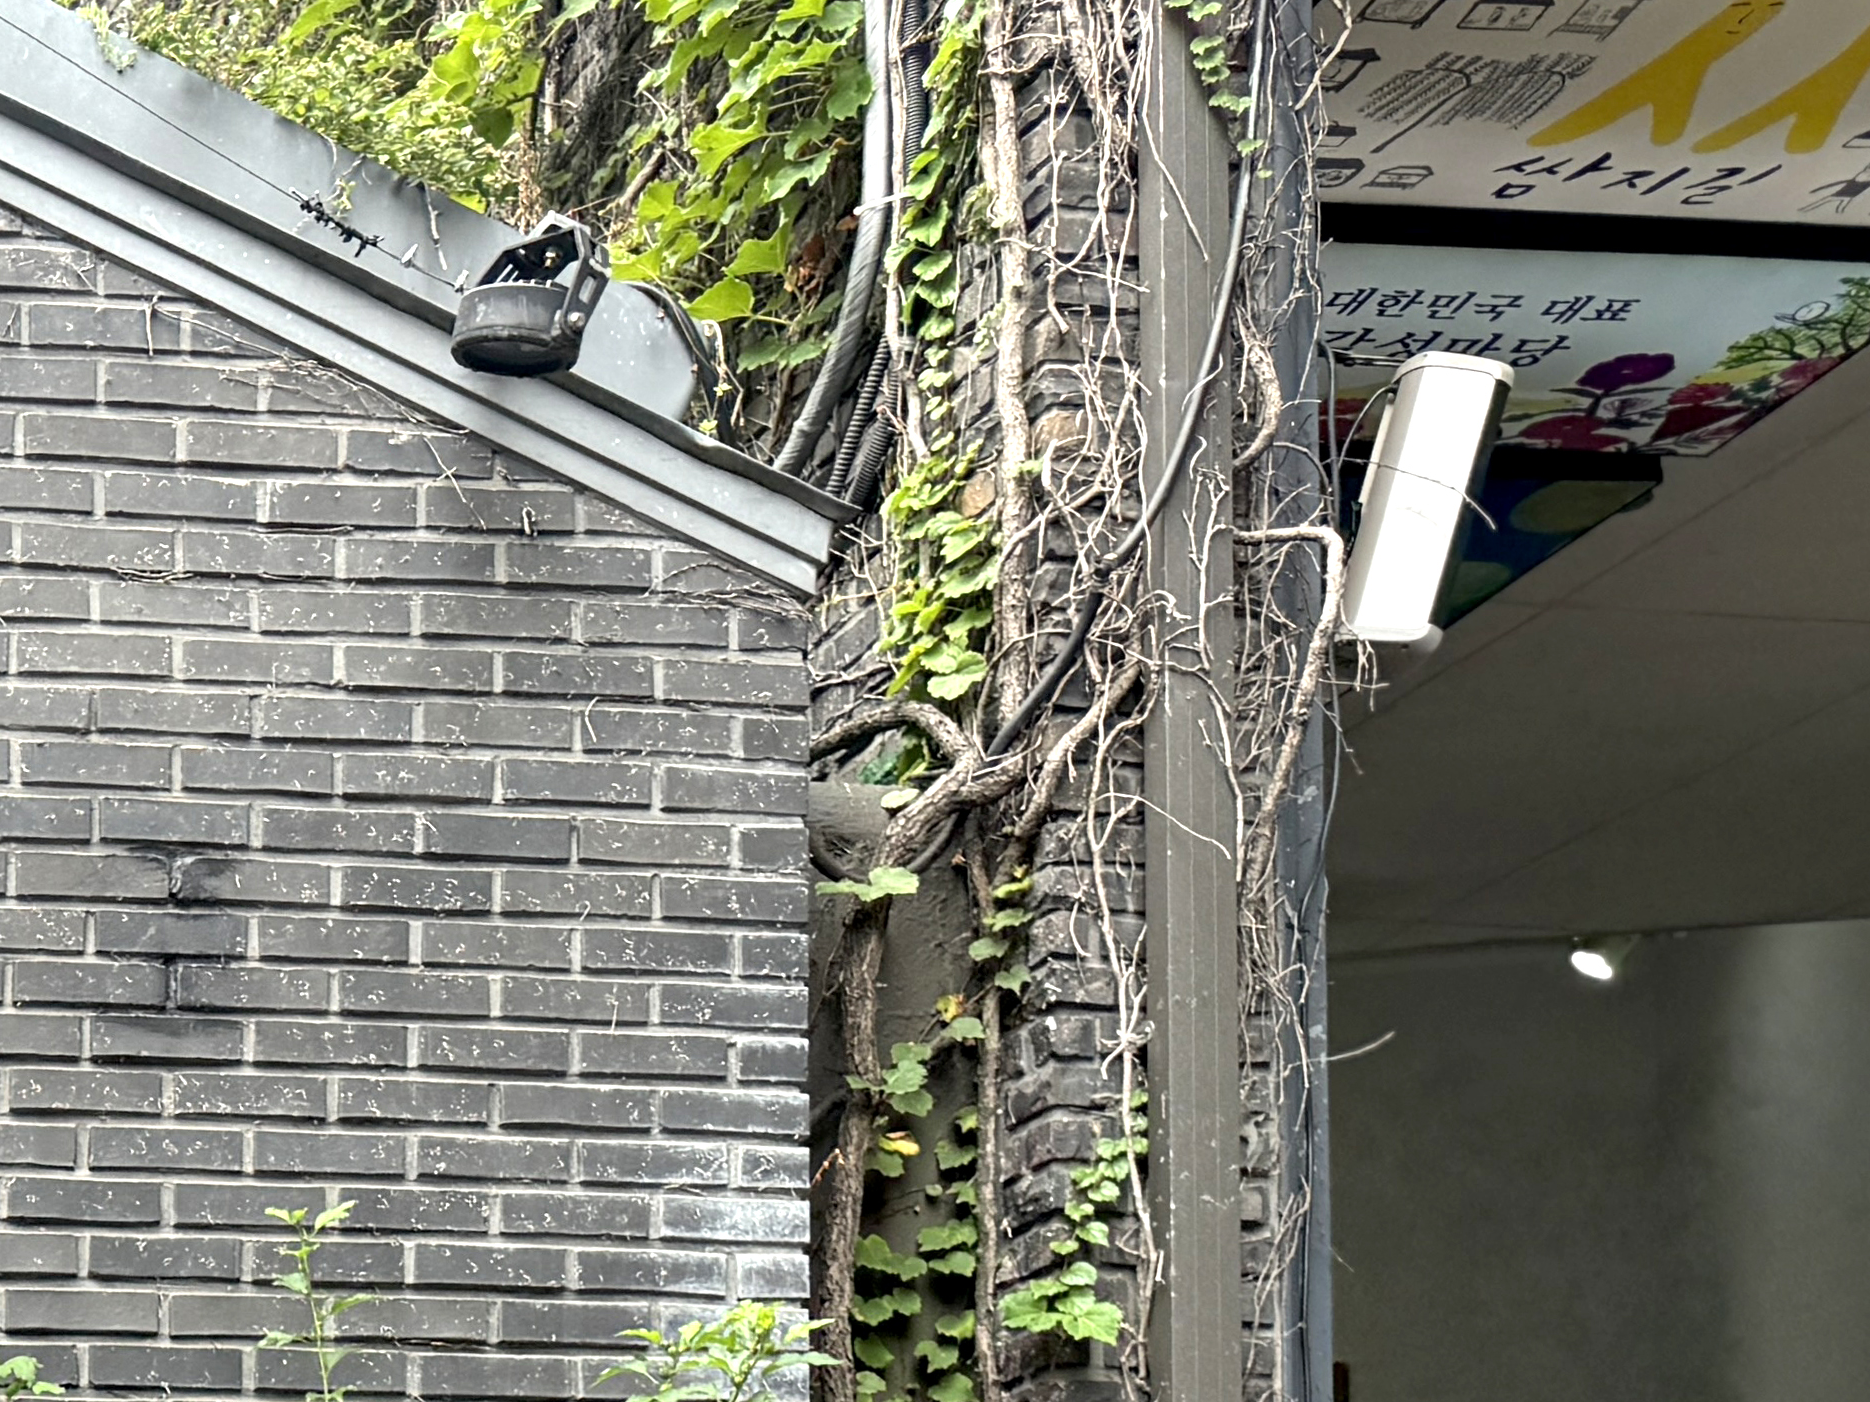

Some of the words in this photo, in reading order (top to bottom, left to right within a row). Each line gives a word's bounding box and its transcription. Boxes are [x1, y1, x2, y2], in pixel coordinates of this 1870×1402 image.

[1493, 151, 1782, 205] 쌈지길
[1325, 287, 1525, 323] 대한민국
[1539, 294, 1641, 325] 대표
